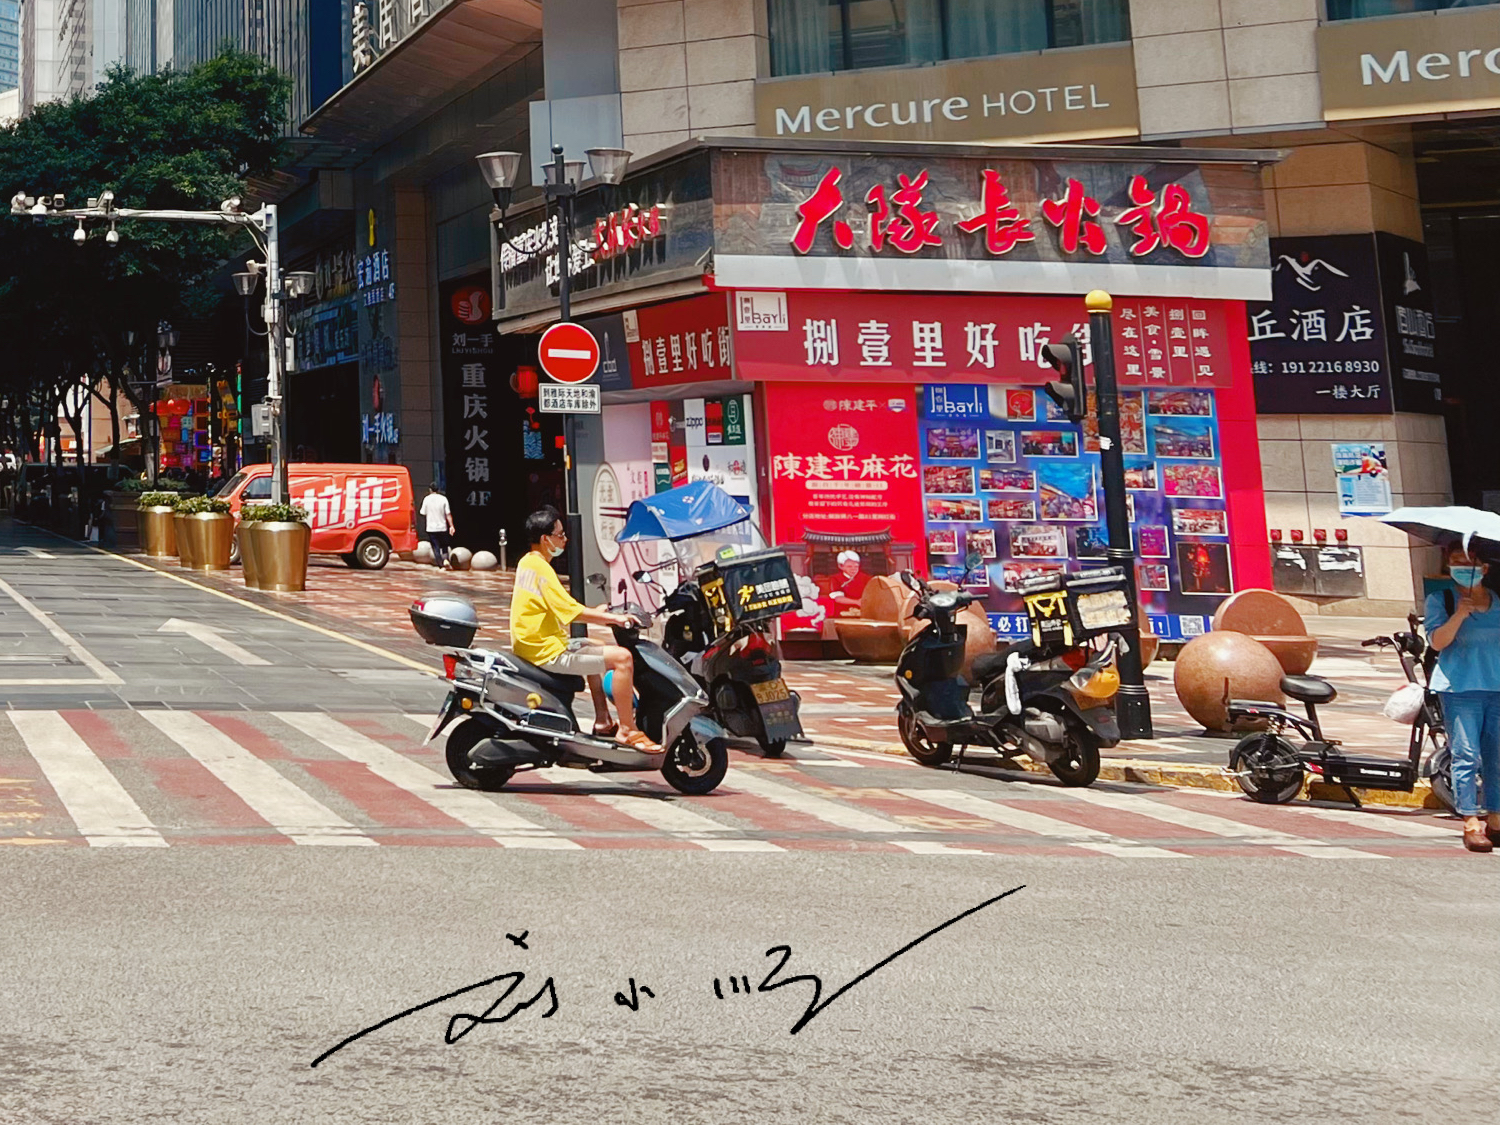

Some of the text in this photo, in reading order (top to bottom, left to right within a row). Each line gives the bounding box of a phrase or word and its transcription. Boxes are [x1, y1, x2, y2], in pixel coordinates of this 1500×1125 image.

[775, 84, 1110, 135] Mercure HOTEL
[452, 333, 494, 348] 刘一手
[1247, 305, 1375, 343] 丘酒店
[642, 326, 731, 376] 捌壹里好吃街
[1315, 384, 1381, 399] 一楼大厅
[461, 363, 490, 482] 重庆火锅
[773, 452, 918, 480] 陳建平麻花
[466, 490, 492, 507] 4F
